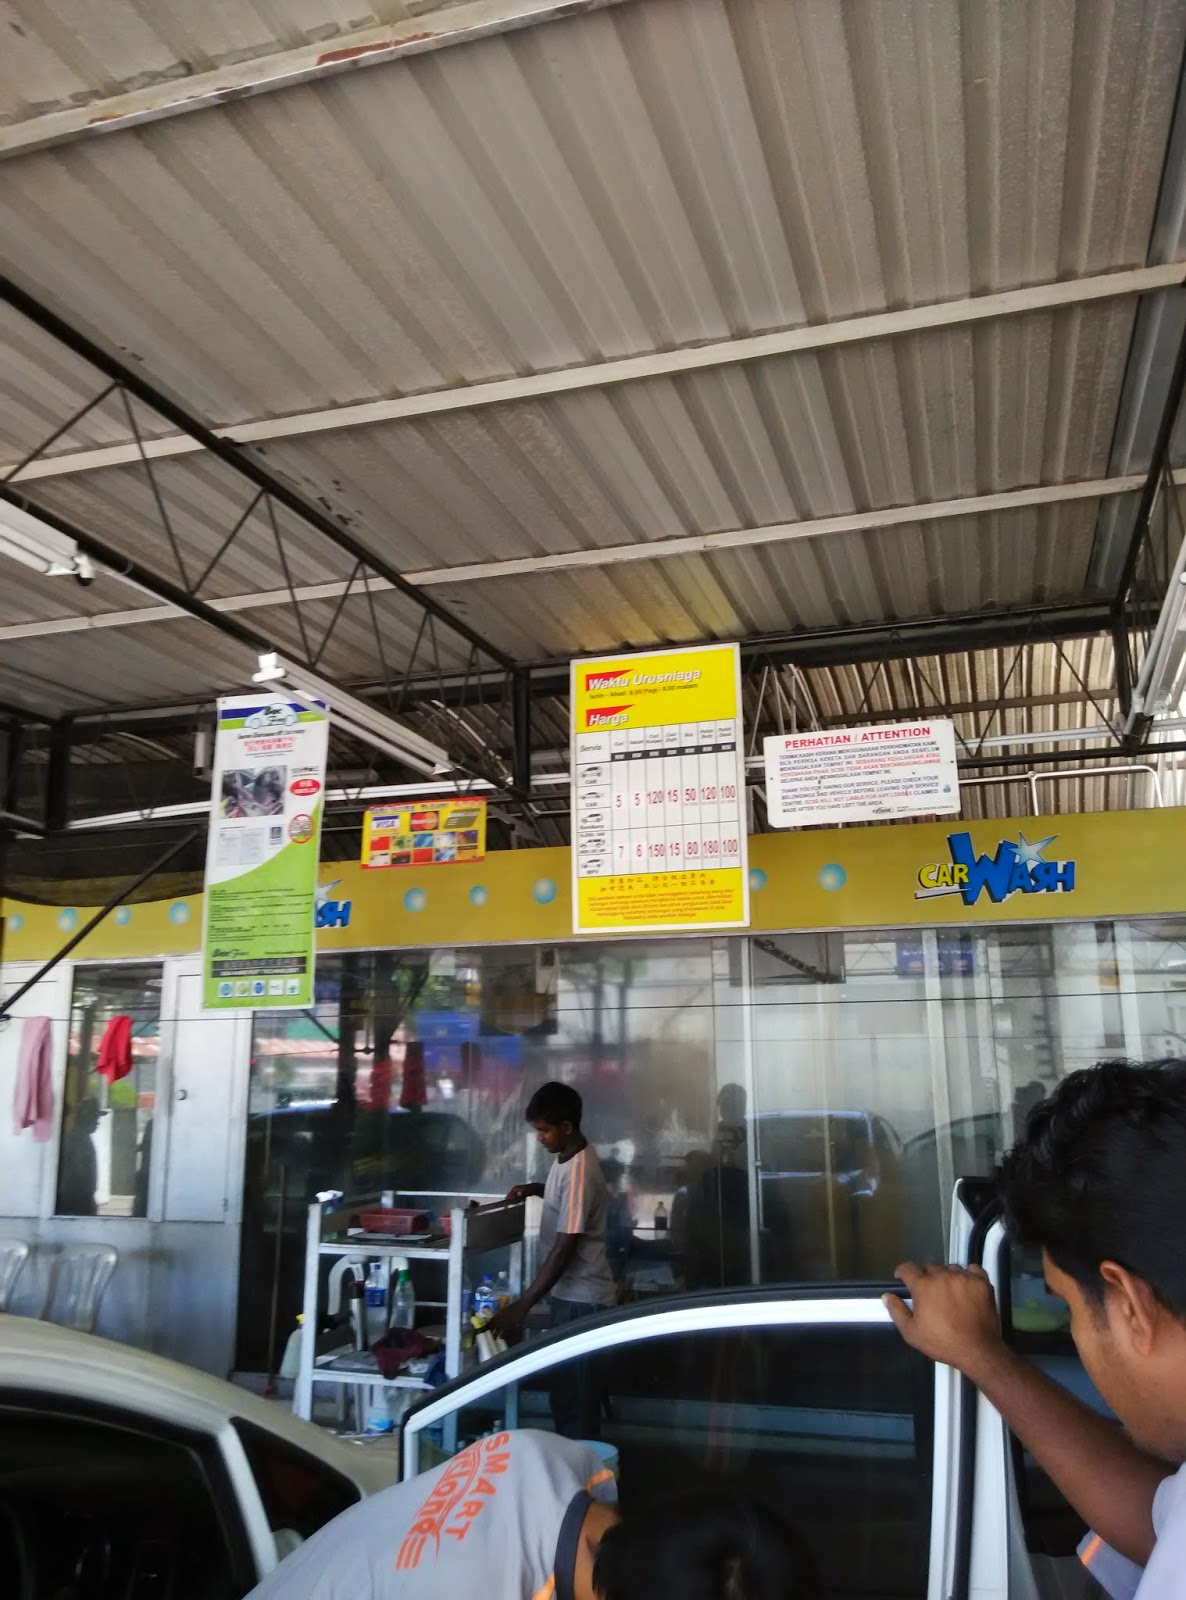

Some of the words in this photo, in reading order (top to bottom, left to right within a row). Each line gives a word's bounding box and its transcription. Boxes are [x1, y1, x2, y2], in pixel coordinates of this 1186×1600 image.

[588, 676, 629, 690] Waktu
[632, 669, 701, 686] Urusniaga
[589, 714, 628, 727] Harga
[785, 735, 850, 748] PERHATIAN
[862, 727, 930, 742] ATTENTION
[616, 795, 622, 808] 5
[634, 793, 640, 806] 5
[647, 791, 664, 804] 120
[668, 790, 678, 802] 15
[685, 788, 696, 802] 50
[702, 786, 716, 800] 120
[720, 785, 736, 799] 100
[618, 846, 624, 858] 7
[636, 844, 642, 857] 6
[650, 844, 664, 858] 150
[670, 842, 680, 856] 15
[688, 842, 698, 856] 80
[704, 840, 718, 854] 180
[722, 840, 738, 853] 100
[918, 864, 969, 889] CAR
[947, 832, 1075, 906] WASH
[446, 1432, 510, 1543] SMART
